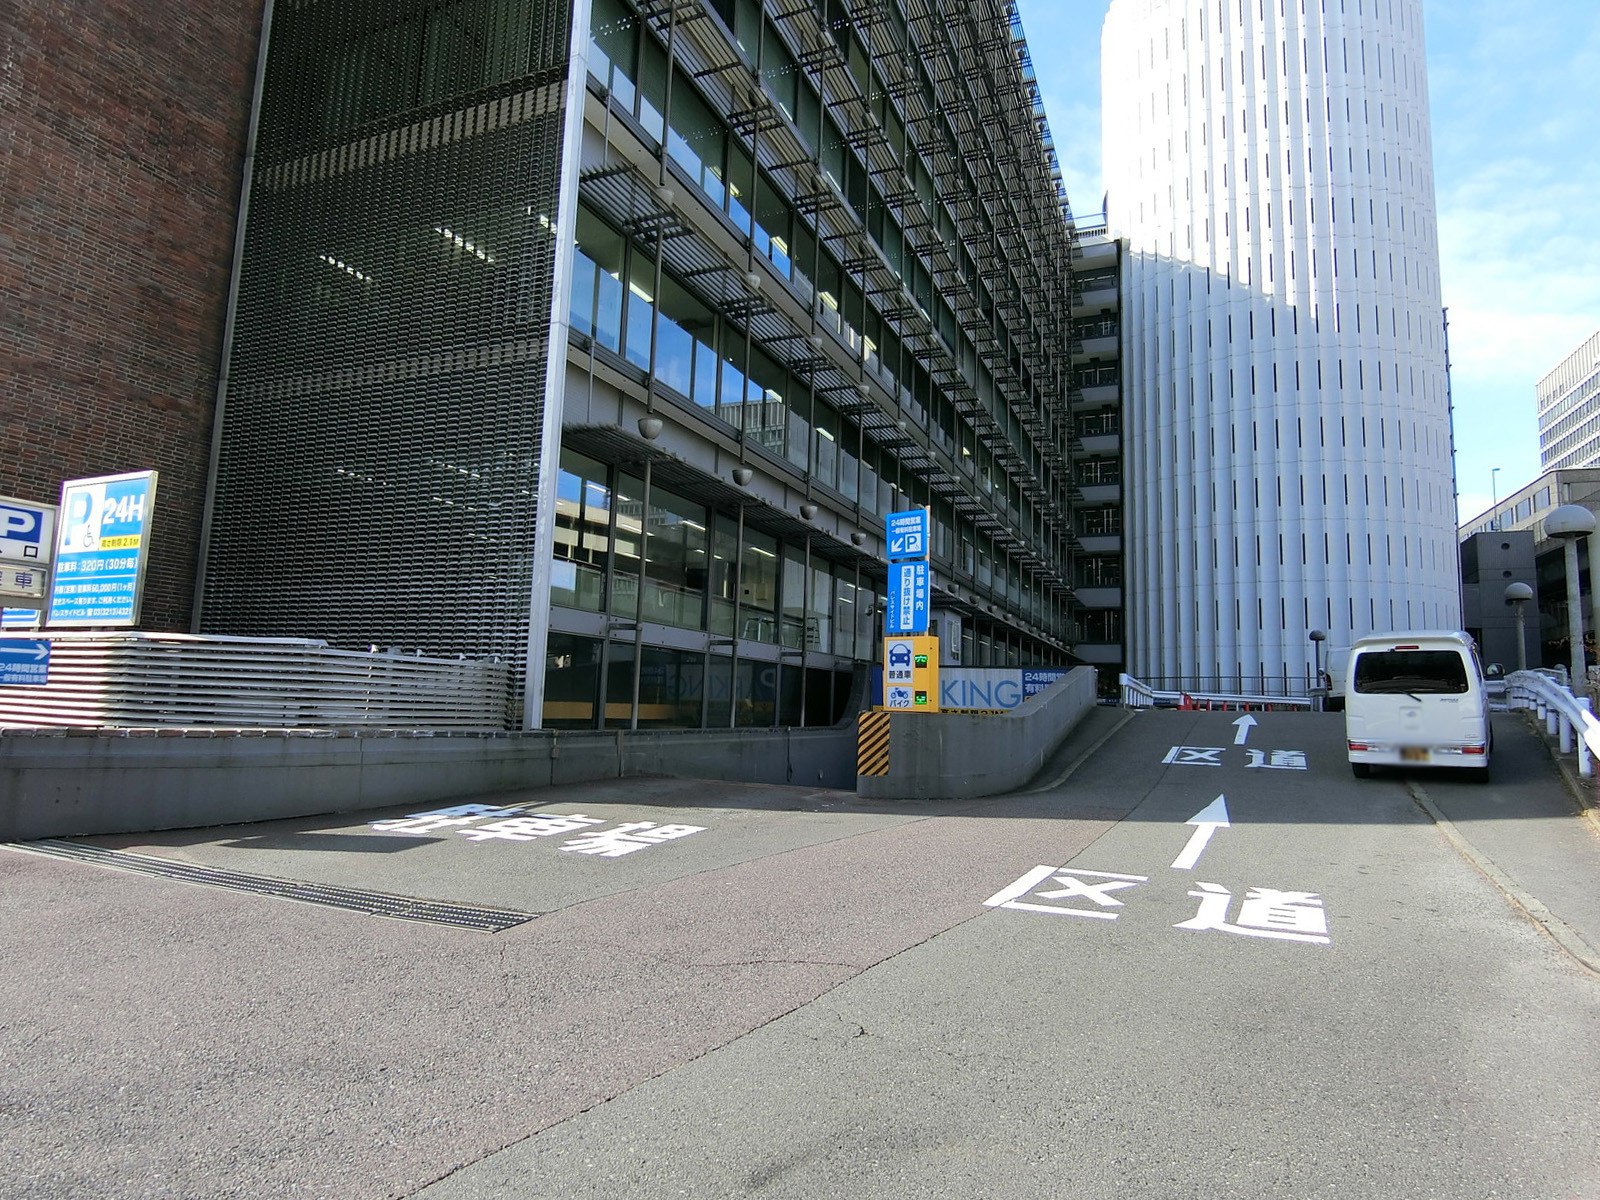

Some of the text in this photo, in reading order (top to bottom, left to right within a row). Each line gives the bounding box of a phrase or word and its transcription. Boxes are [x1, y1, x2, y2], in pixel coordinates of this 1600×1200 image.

[0, 508, 35, 537] P
[102, 494, 145, 525] 24H
[907, 535, 917, 550] P
[902, 568, 912, 625] 通り抜け禁止
[916, 564, 925, 611] 駐車場内
[888, 670, 911, 679] 普通車
[889, 699, 910, 707] バイク
